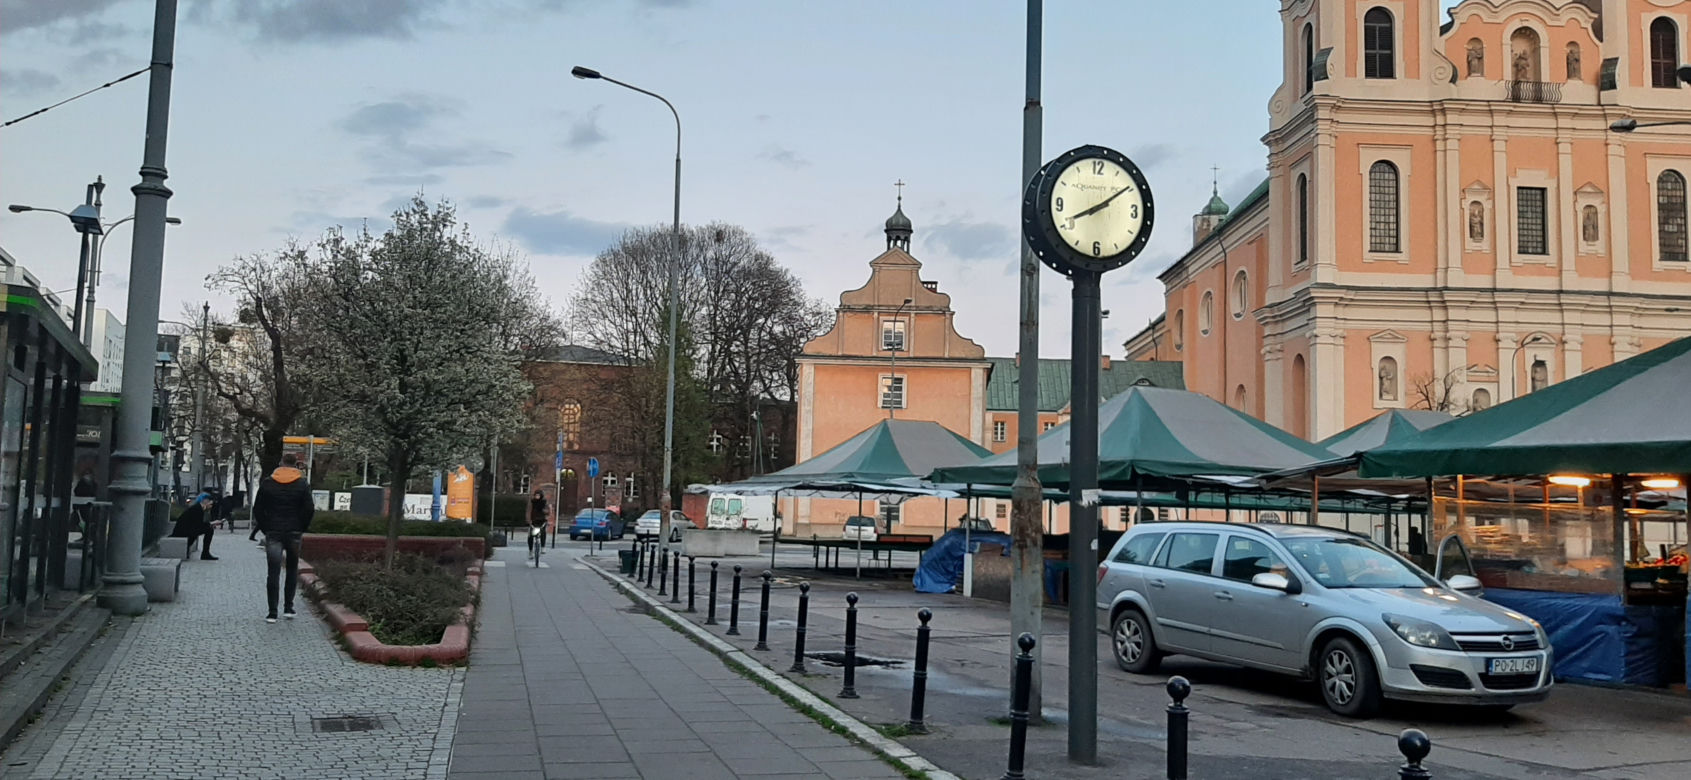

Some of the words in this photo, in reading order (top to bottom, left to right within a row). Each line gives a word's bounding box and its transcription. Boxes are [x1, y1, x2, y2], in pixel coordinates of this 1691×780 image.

[1092, 160, 1104, 175] 12
[1055, 197, 1064, 212] 9
[1130, 204, 1138, 219] 3
[1092, 241, 1101, 256] 6
